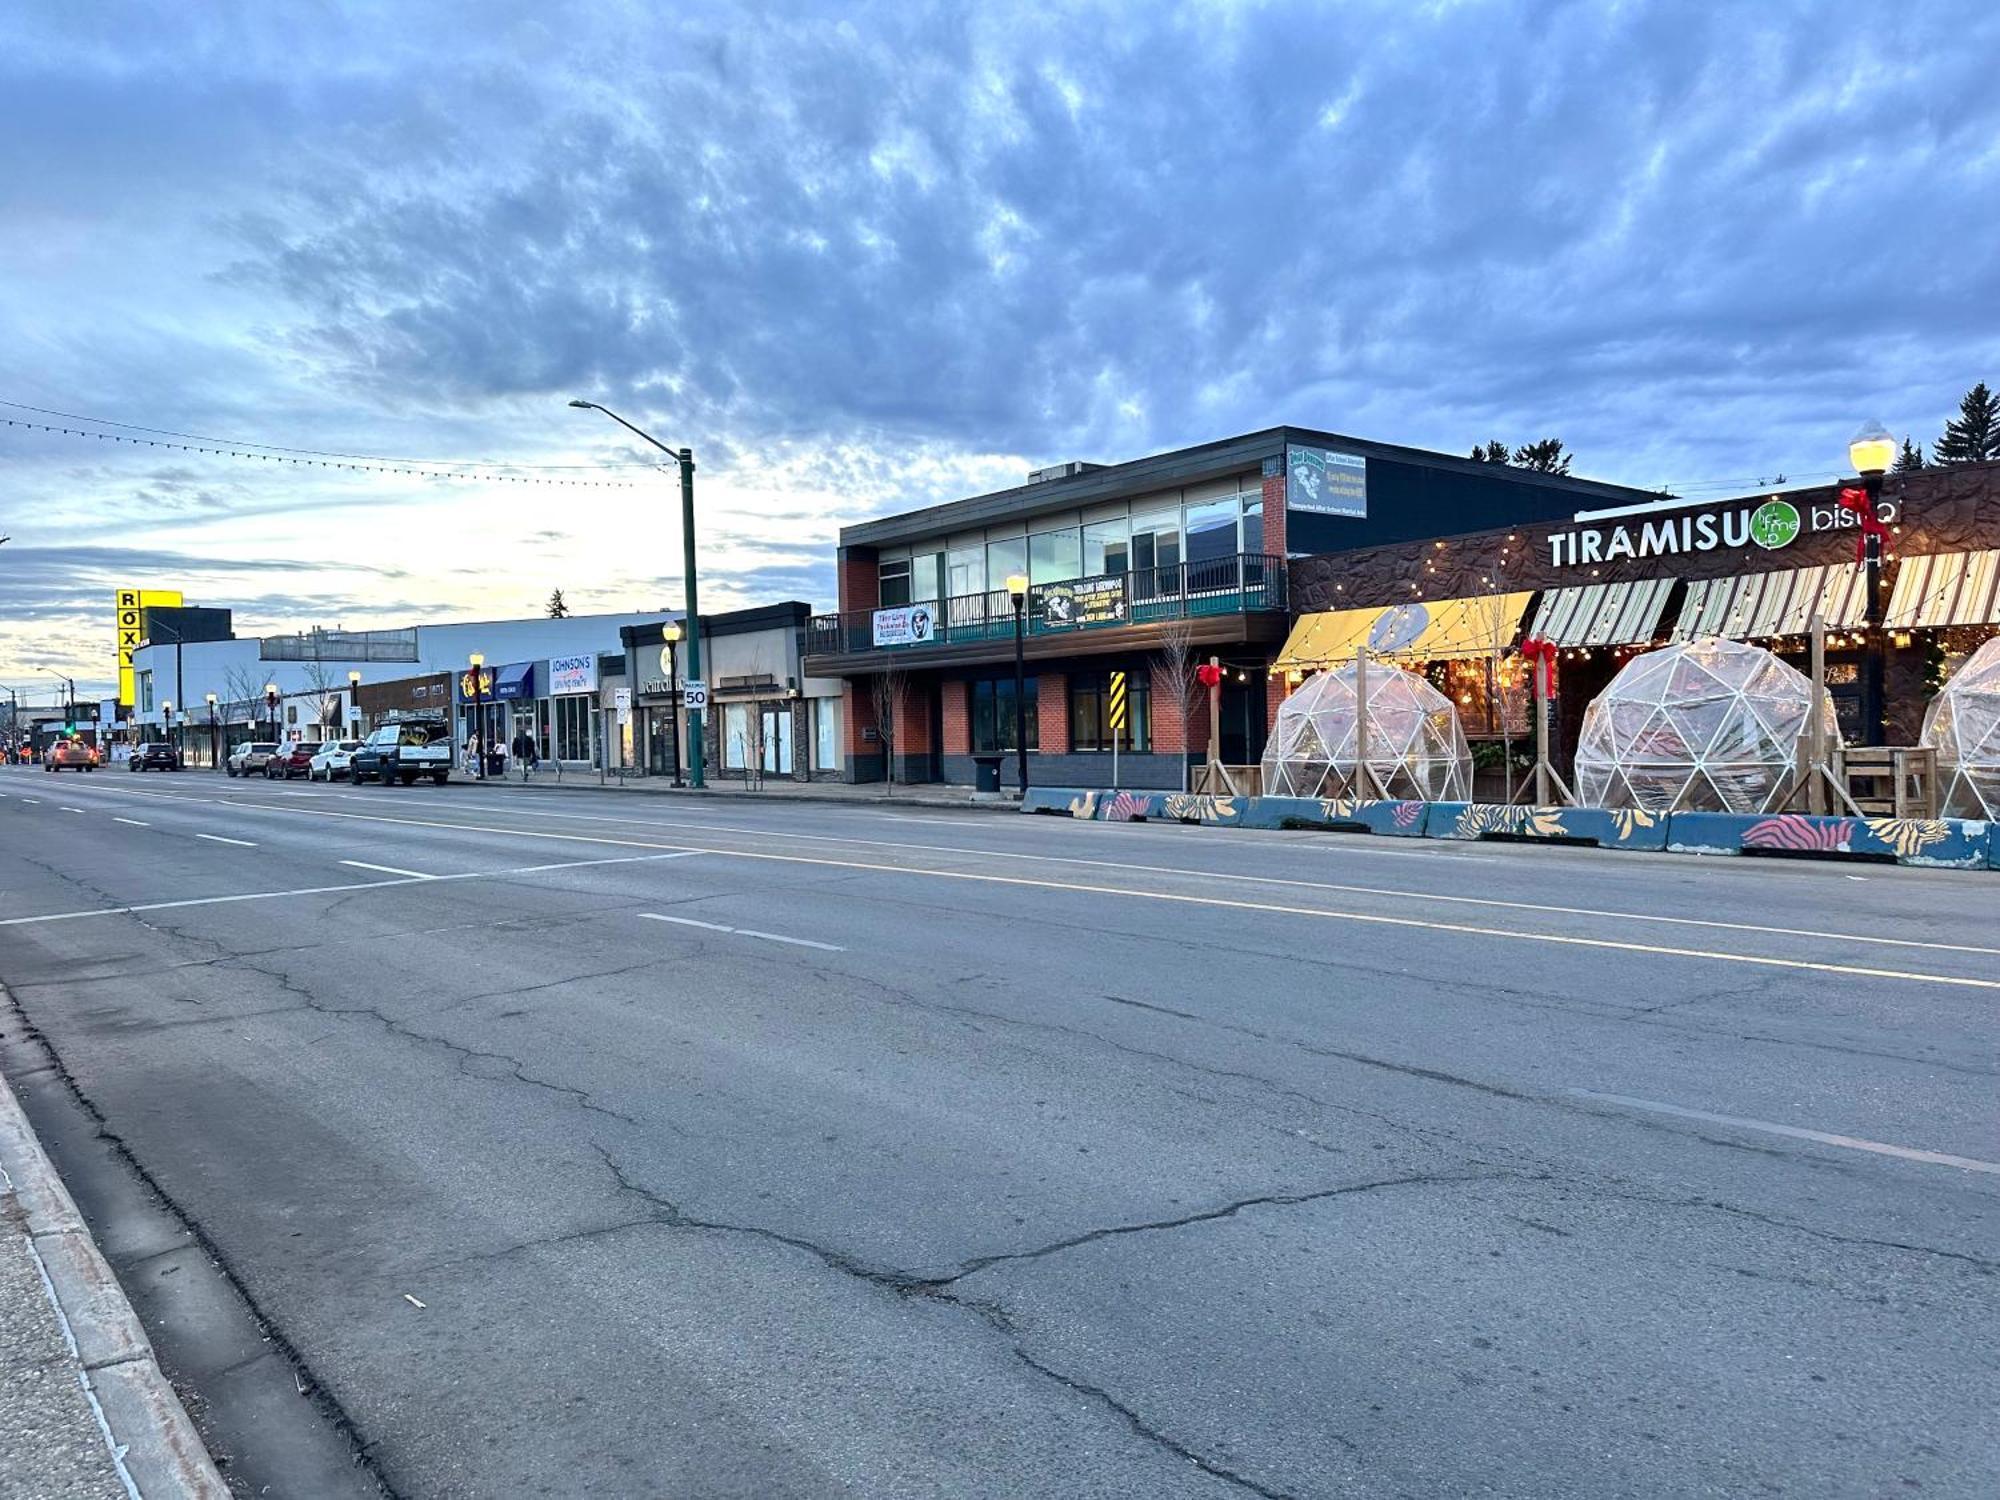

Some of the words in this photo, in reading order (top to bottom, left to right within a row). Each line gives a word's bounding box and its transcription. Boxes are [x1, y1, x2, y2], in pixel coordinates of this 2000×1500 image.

[1548, 509, 1749, 567] TIRAMISU
[122, 593, 136, 664] ROXY
[686, 691, 705, 704] 50
